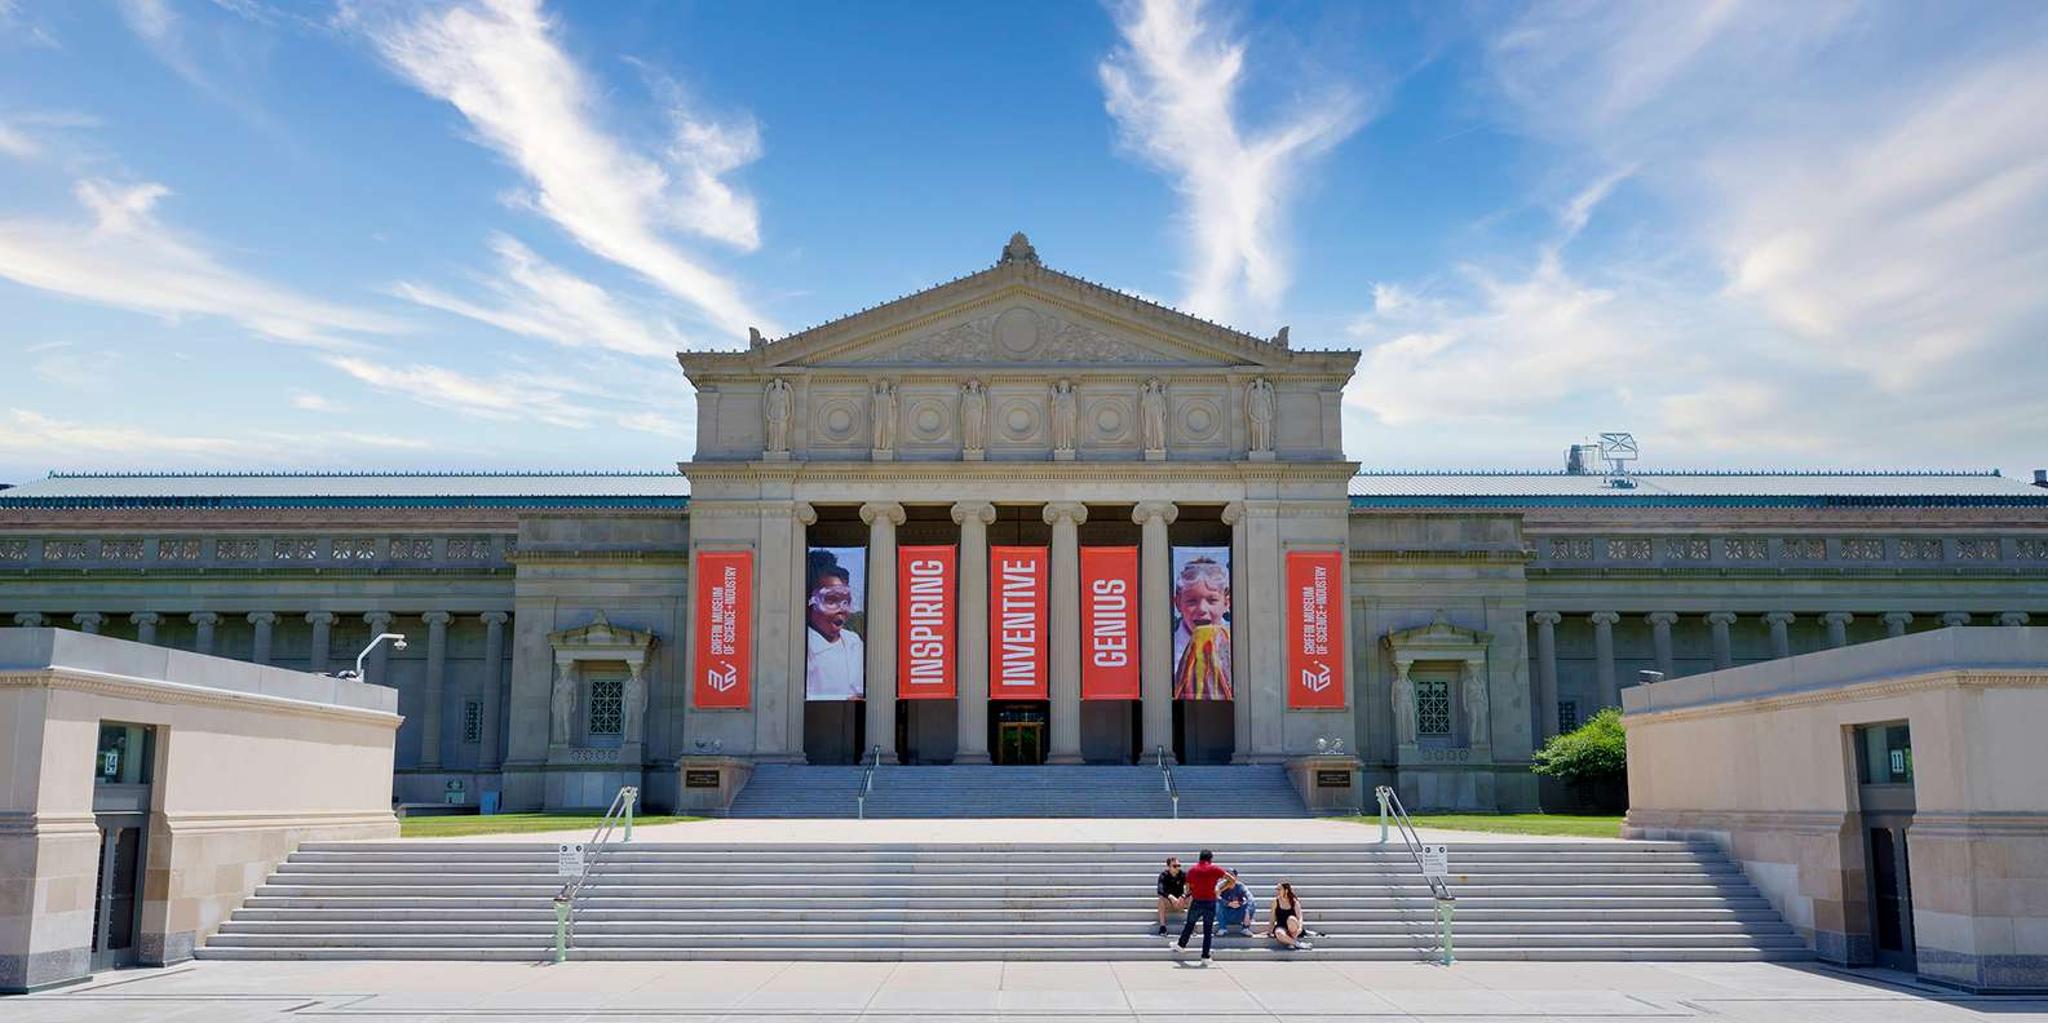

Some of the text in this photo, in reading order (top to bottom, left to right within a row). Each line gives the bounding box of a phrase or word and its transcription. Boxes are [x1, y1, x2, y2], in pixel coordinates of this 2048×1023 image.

[712, 587, 723, 622] MUSEUM
[910, 560, 944, 684] INSPIRING
[1002, 560, 1036, 686] INVENTIVE
[1093, 579, 1128, 667] GENIUS
[1302, 587, 1315, 654] GRIFFIN MUSEUM
[711, 624, 723, 654] GRIFFIN
[723, 643, 735, 654] OF
[1316, 643, 1328, 654] OF
